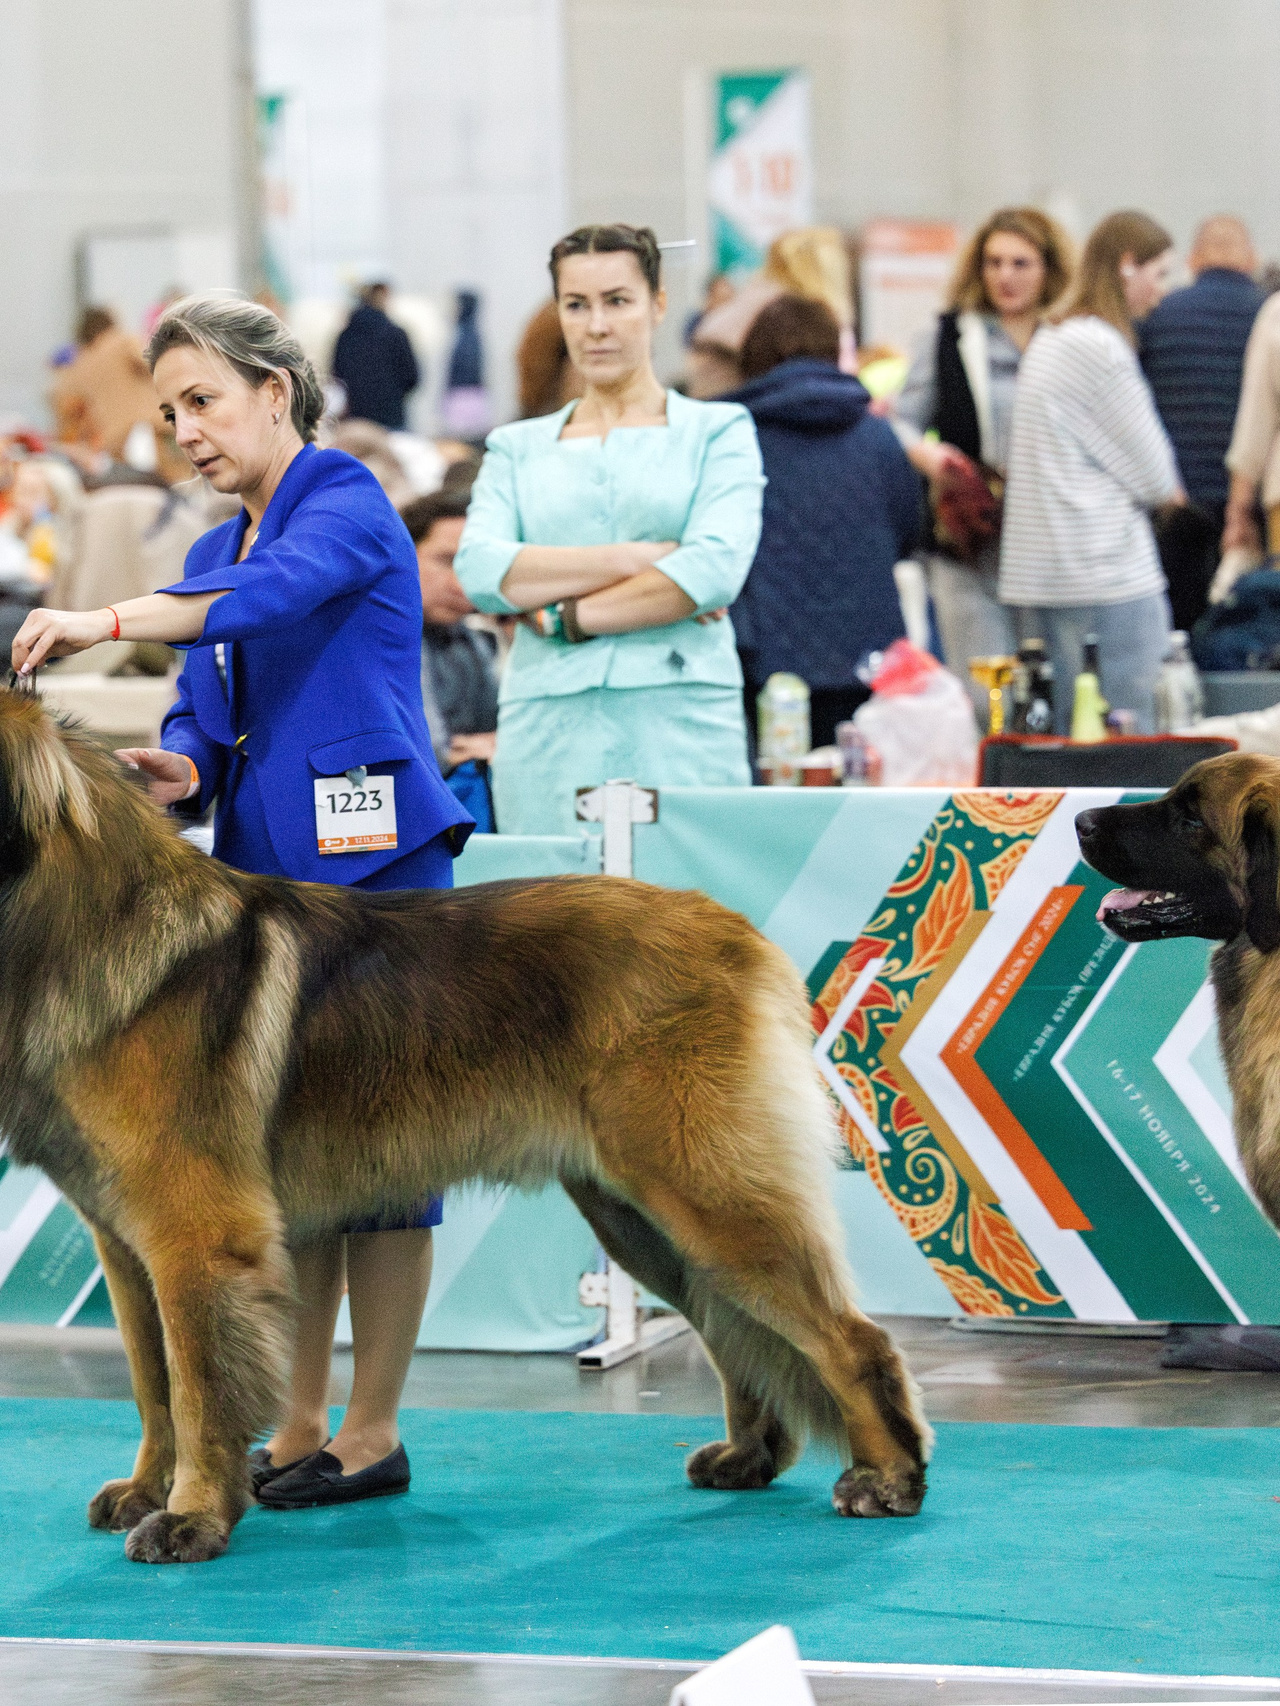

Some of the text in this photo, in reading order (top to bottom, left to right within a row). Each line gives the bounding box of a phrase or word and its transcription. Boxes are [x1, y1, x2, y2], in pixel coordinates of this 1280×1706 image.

[326, 789, 383, 814] 1223
[1107, 1059, 1222, 1215] 16-17 НОЯБРЯ 2024
